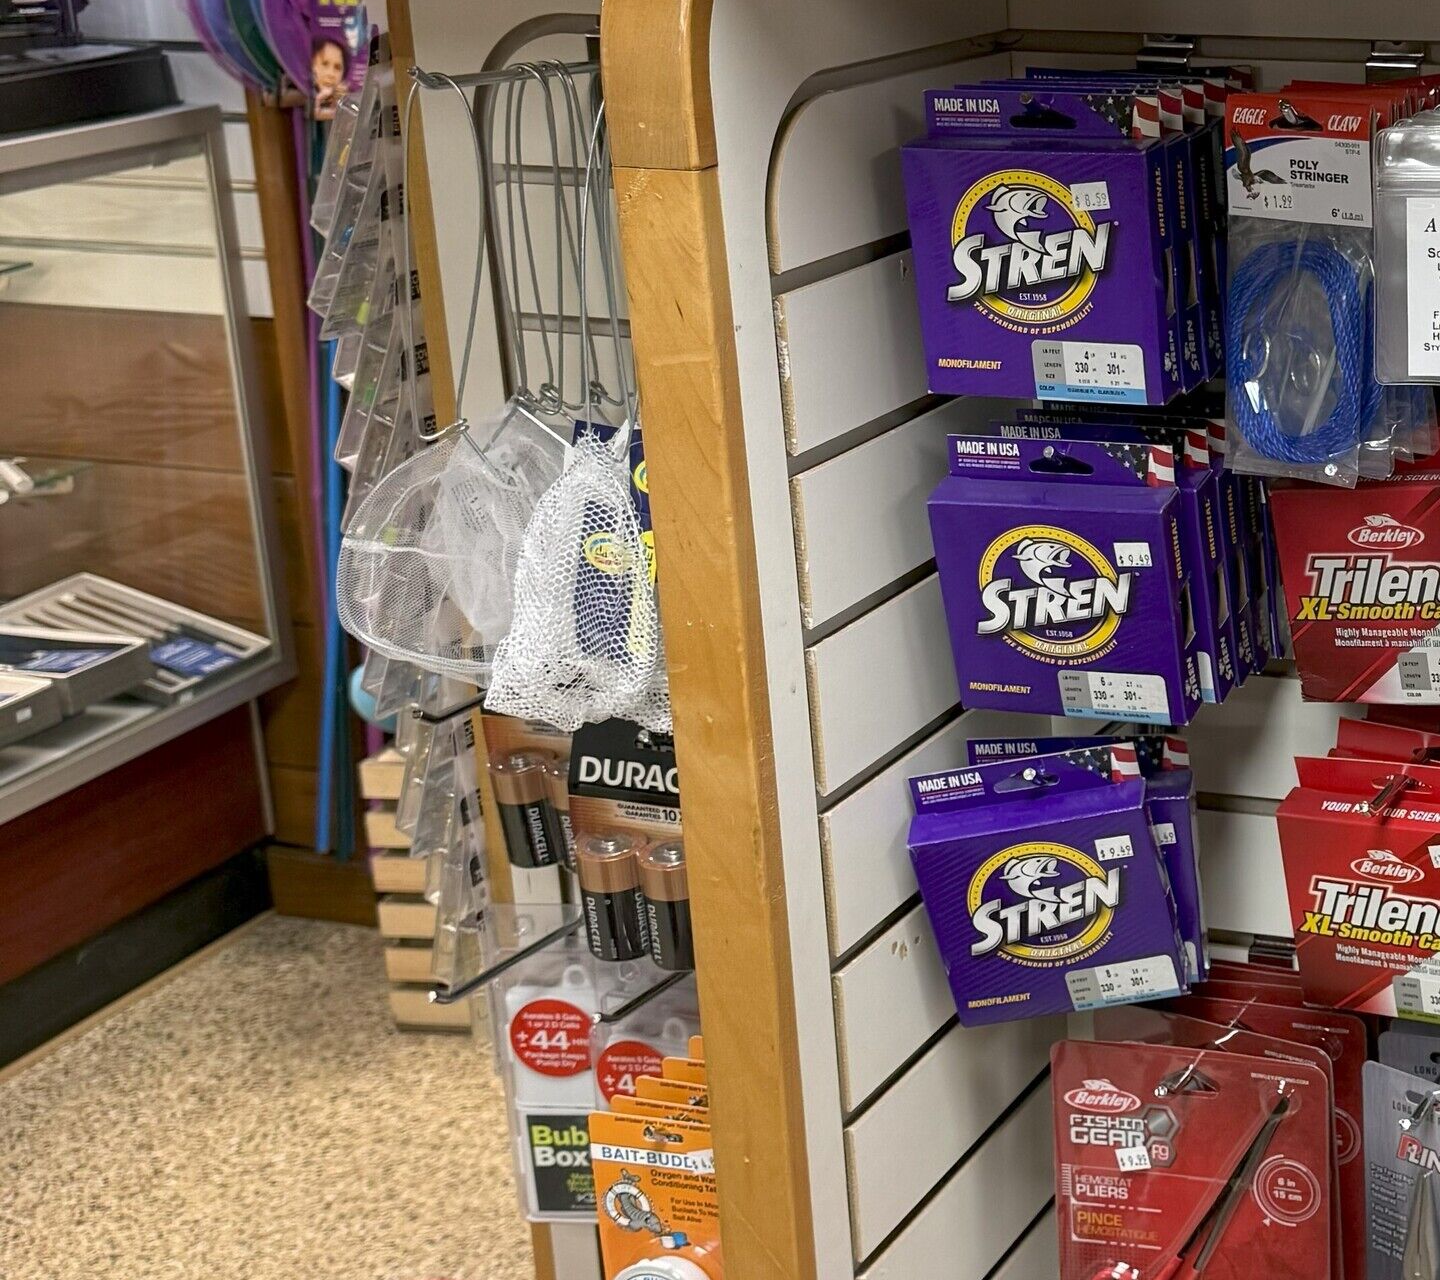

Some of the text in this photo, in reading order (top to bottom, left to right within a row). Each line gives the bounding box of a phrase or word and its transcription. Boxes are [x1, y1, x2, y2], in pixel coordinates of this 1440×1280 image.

[934, 99, 1000, 113] MADE IN USA
[1233, 107, 1362, 133] EAGLE CLAW
[1290, 159, 1319, 170] POLY
[1290, 170, 1349, 184] STRINGER
[1424, 218, 1437, 233] A
[947, 221, 1111, 302] STREN
[938, 358, 1002, 370] MONOFILAMENT
[957, 440, 1020, 457] MADE IN USA
[1358, 528, 1416, 546] Berkley
[977, 572, 1132, 635] STREN
[1297, 597, 1336, 620] XL
[1335, 602, 1418, 619] Smooth
[969, 682, 1031, 694] MONOFILAMENT
[579, 756, 680, 794] DURAC
[971, 867, 1120, 956] STREN
[586, 897, 602, 954] DURACELL
[530, 1030, 570, 1050] 44
[1075, 1091, 1133, 1109] Berkley
[531, 1125, 588, 1146] Bub
[1070, 1128, 1146, 1147] GEAR
[534, 1147, 590, 1167] Box
[1075, 1175, 1133, 1188] HEMOSTAT
[1076, 1184, 1129, 1200] PLIERS
[1077, 1210, 1122, 1227] PINCE
